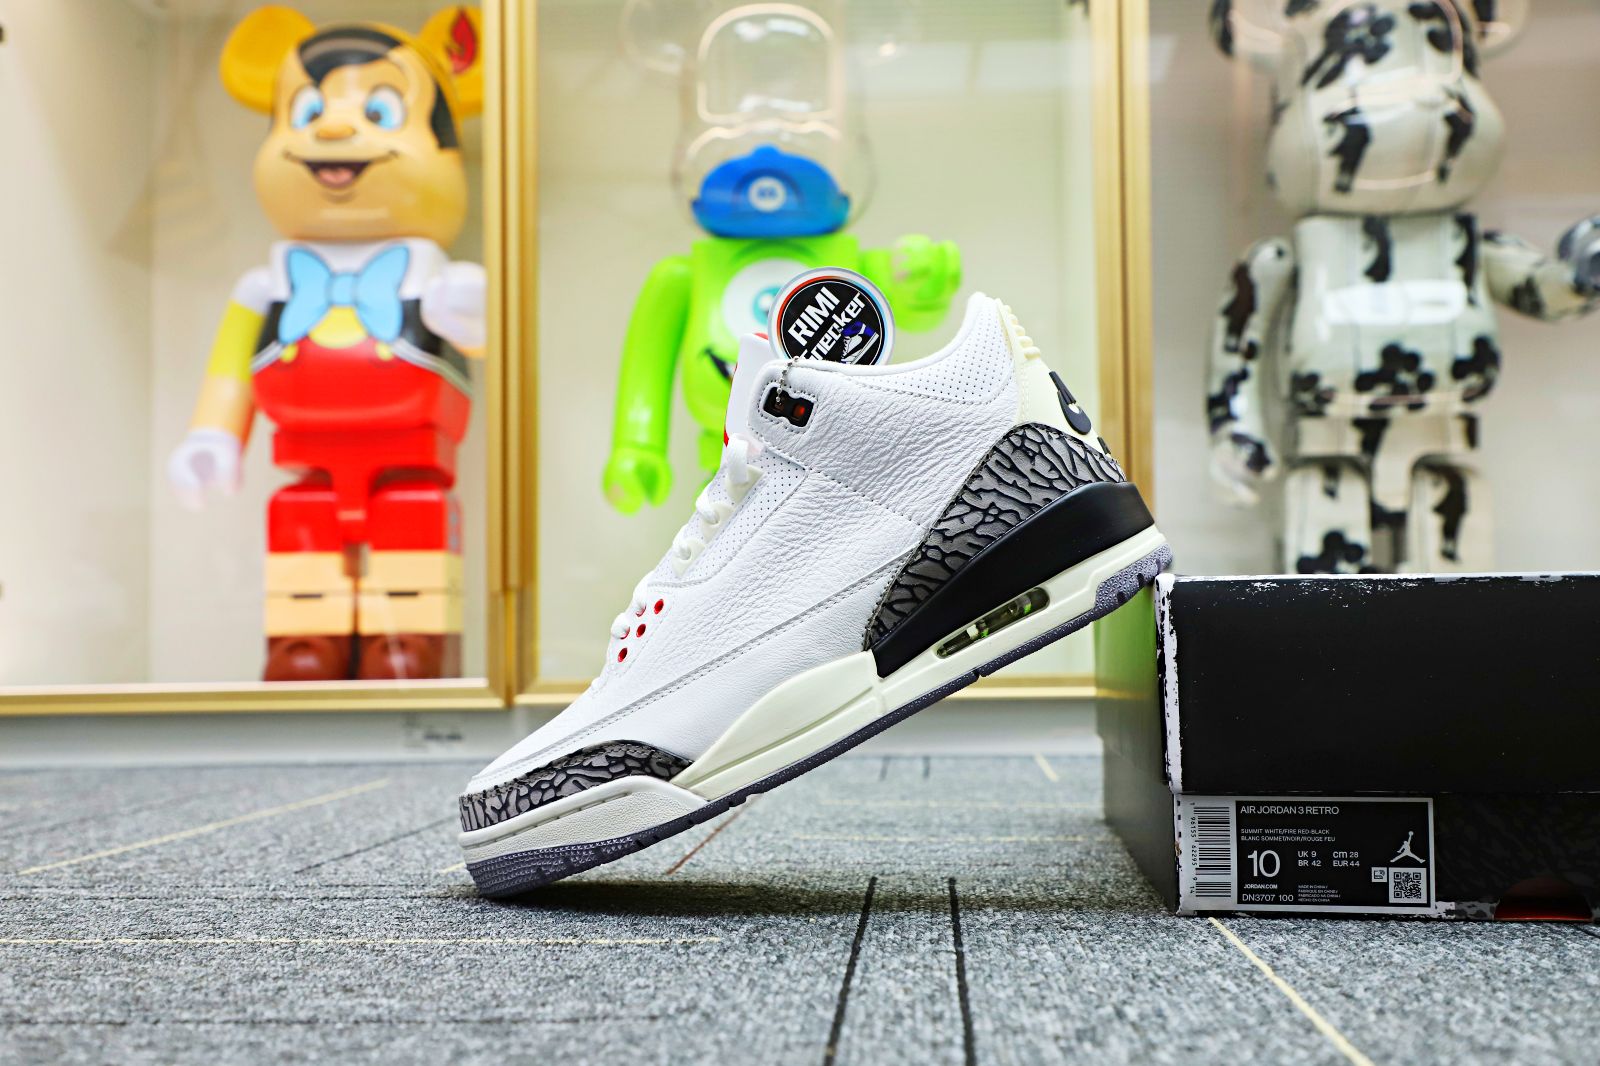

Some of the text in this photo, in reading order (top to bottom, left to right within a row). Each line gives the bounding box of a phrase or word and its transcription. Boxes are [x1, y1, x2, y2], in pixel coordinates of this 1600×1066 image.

[787, 286, 840, 346] RIMI
[1240, 805, 1340, 815] AIR JORDAN 3 RETRO
[1190, 816, 1198, 839] 96155
[1297, 850, 1317, 858] UK 9
[1332, 851, 1359, 859] cm 28
[1247, 849, 1281, 878] 10
[1297, 859, 1322, 867] BR 42
[1242, 893, 1294, 902] DN3707 100
